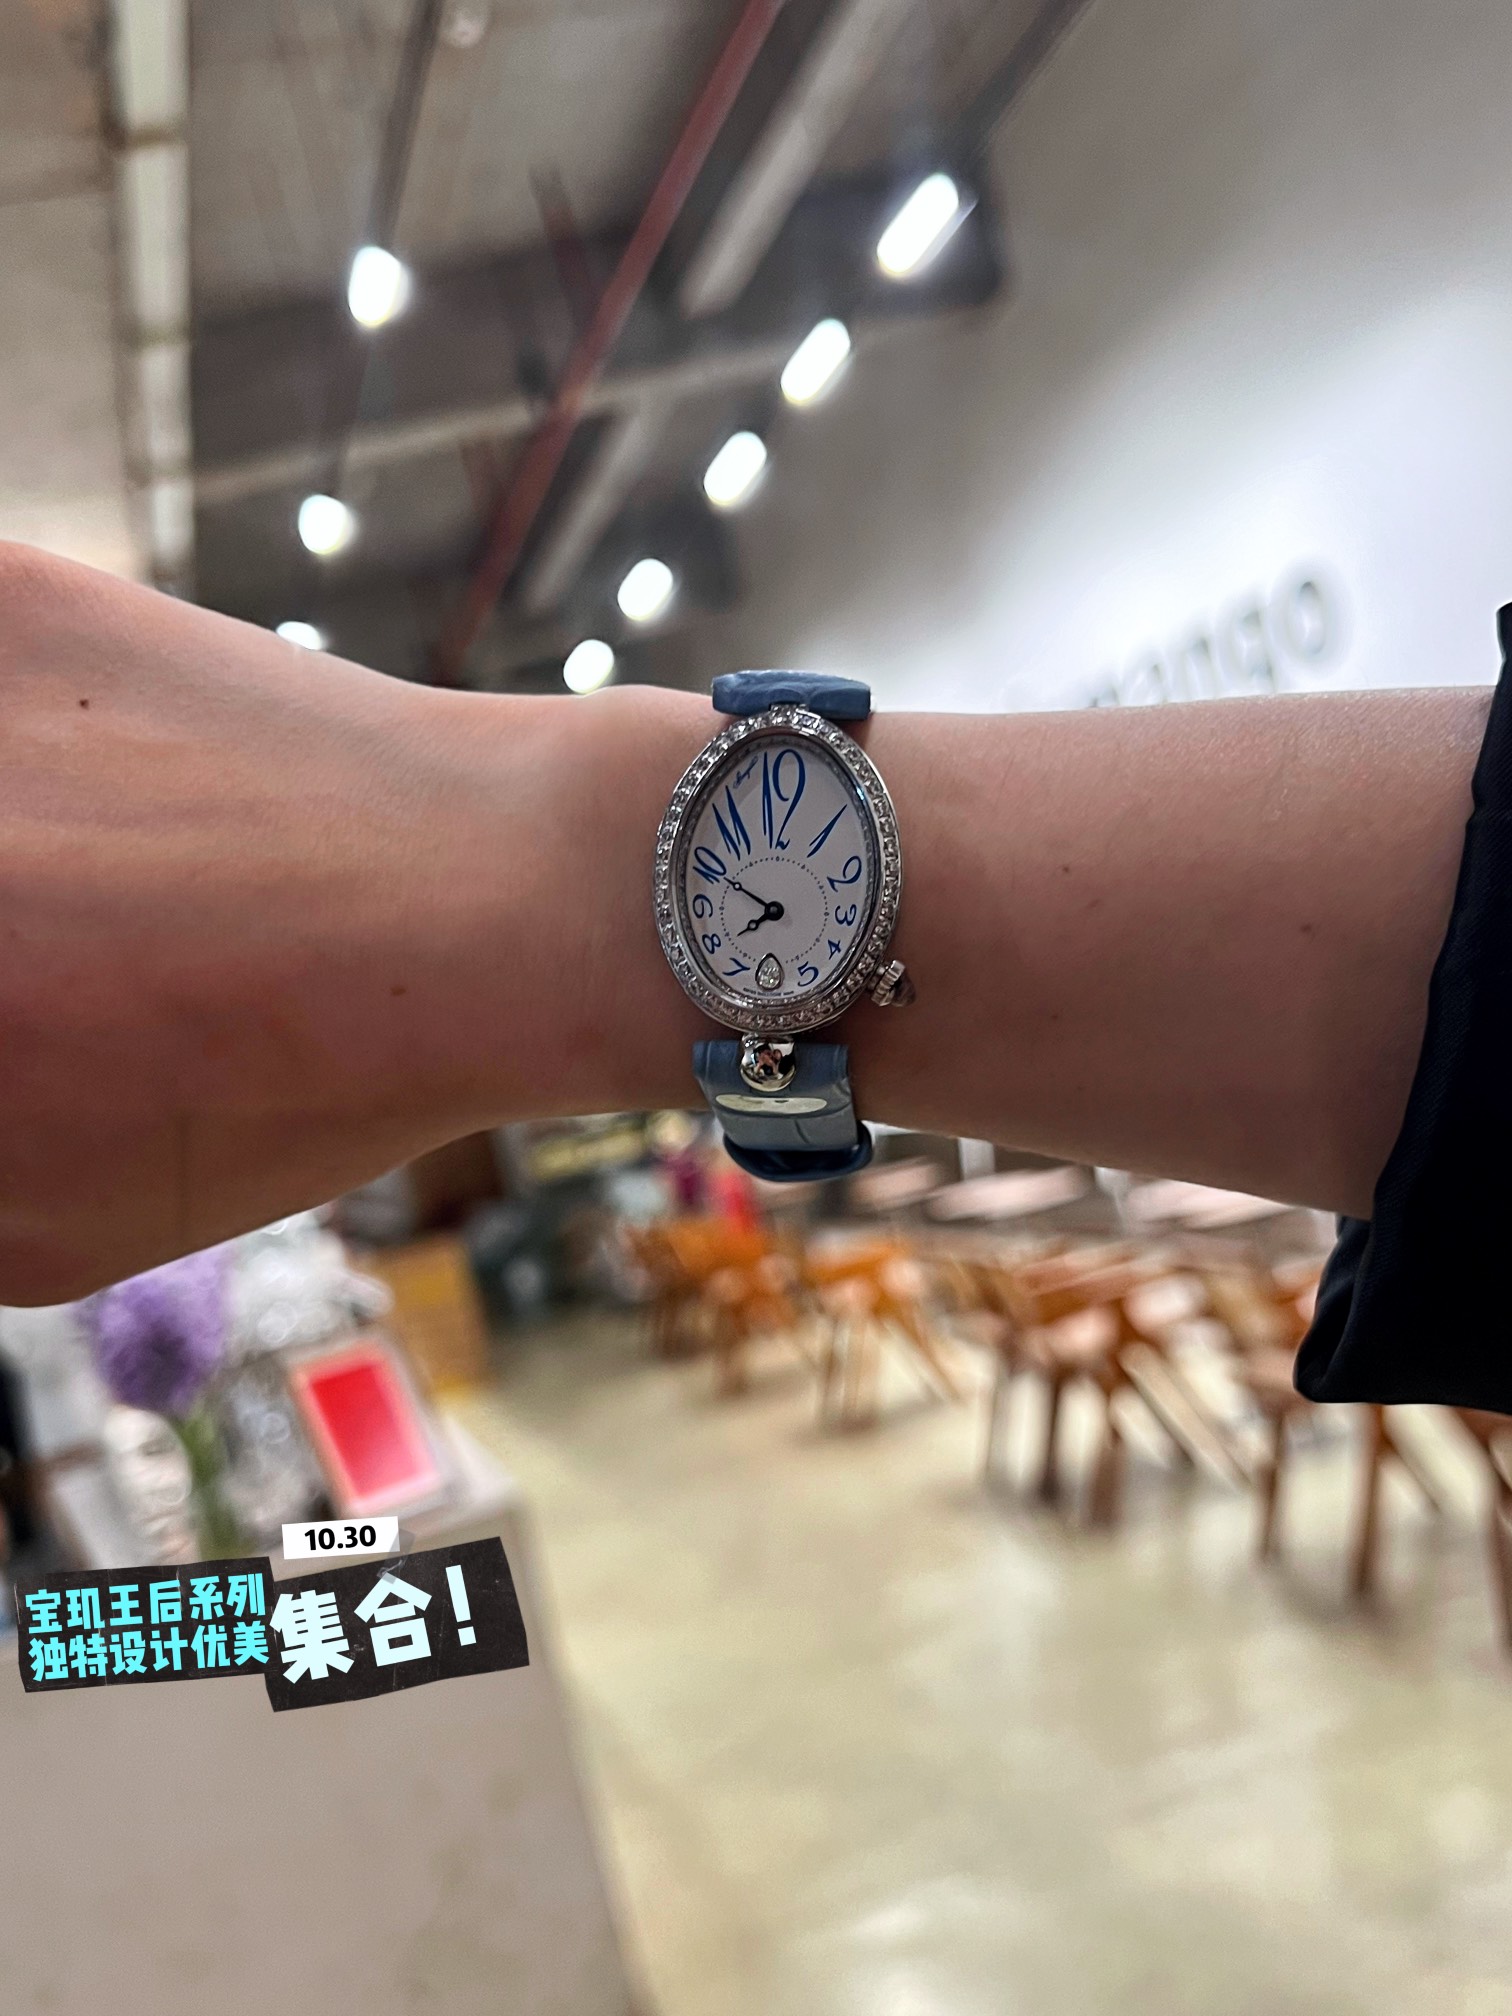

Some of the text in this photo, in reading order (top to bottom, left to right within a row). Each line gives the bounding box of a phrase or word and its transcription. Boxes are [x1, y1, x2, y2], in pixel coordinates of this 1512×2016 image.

[761, 749, 806, 850] 12
[807, 804, 848, 858] 1
[692, 846, 728, 885] 10
[826, 855, 863, 893] 2
[692, 894, 714, 919] 9
[834, 904, 858, 927] 3
[702, 933, 722, 955] 8
[826, 938, 842, 961] 4
[722, 956, 751, 978] 7
[797, 961, 820, 988] 5
